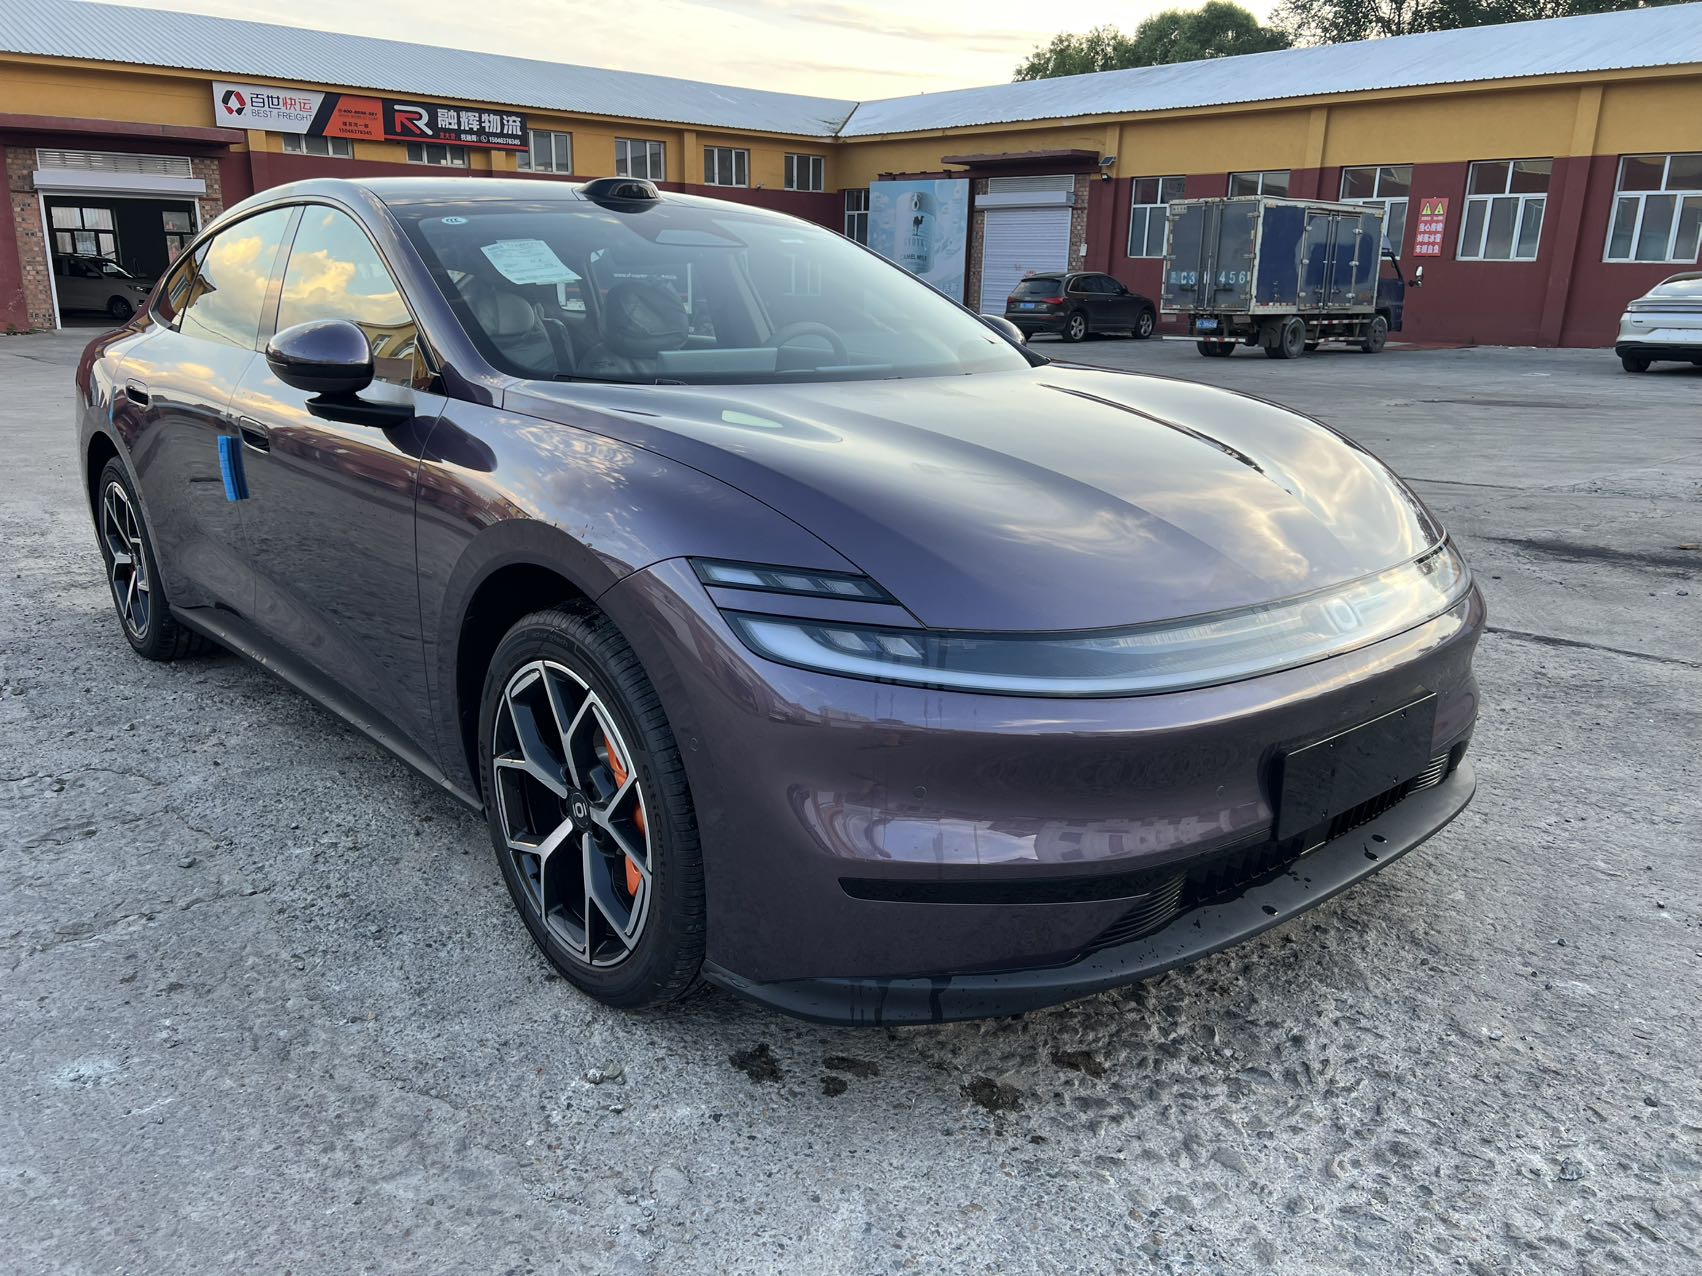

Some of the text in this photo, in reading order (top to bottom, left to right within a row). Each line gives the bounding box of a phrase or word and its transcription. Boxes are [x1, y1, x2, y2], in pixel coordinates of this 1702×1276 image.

[250, 93, 312, 112] 百世快运
[251, 109, 313, 122] BEST FREIGHT
[437, 108, 522, 135] 融辉物流
